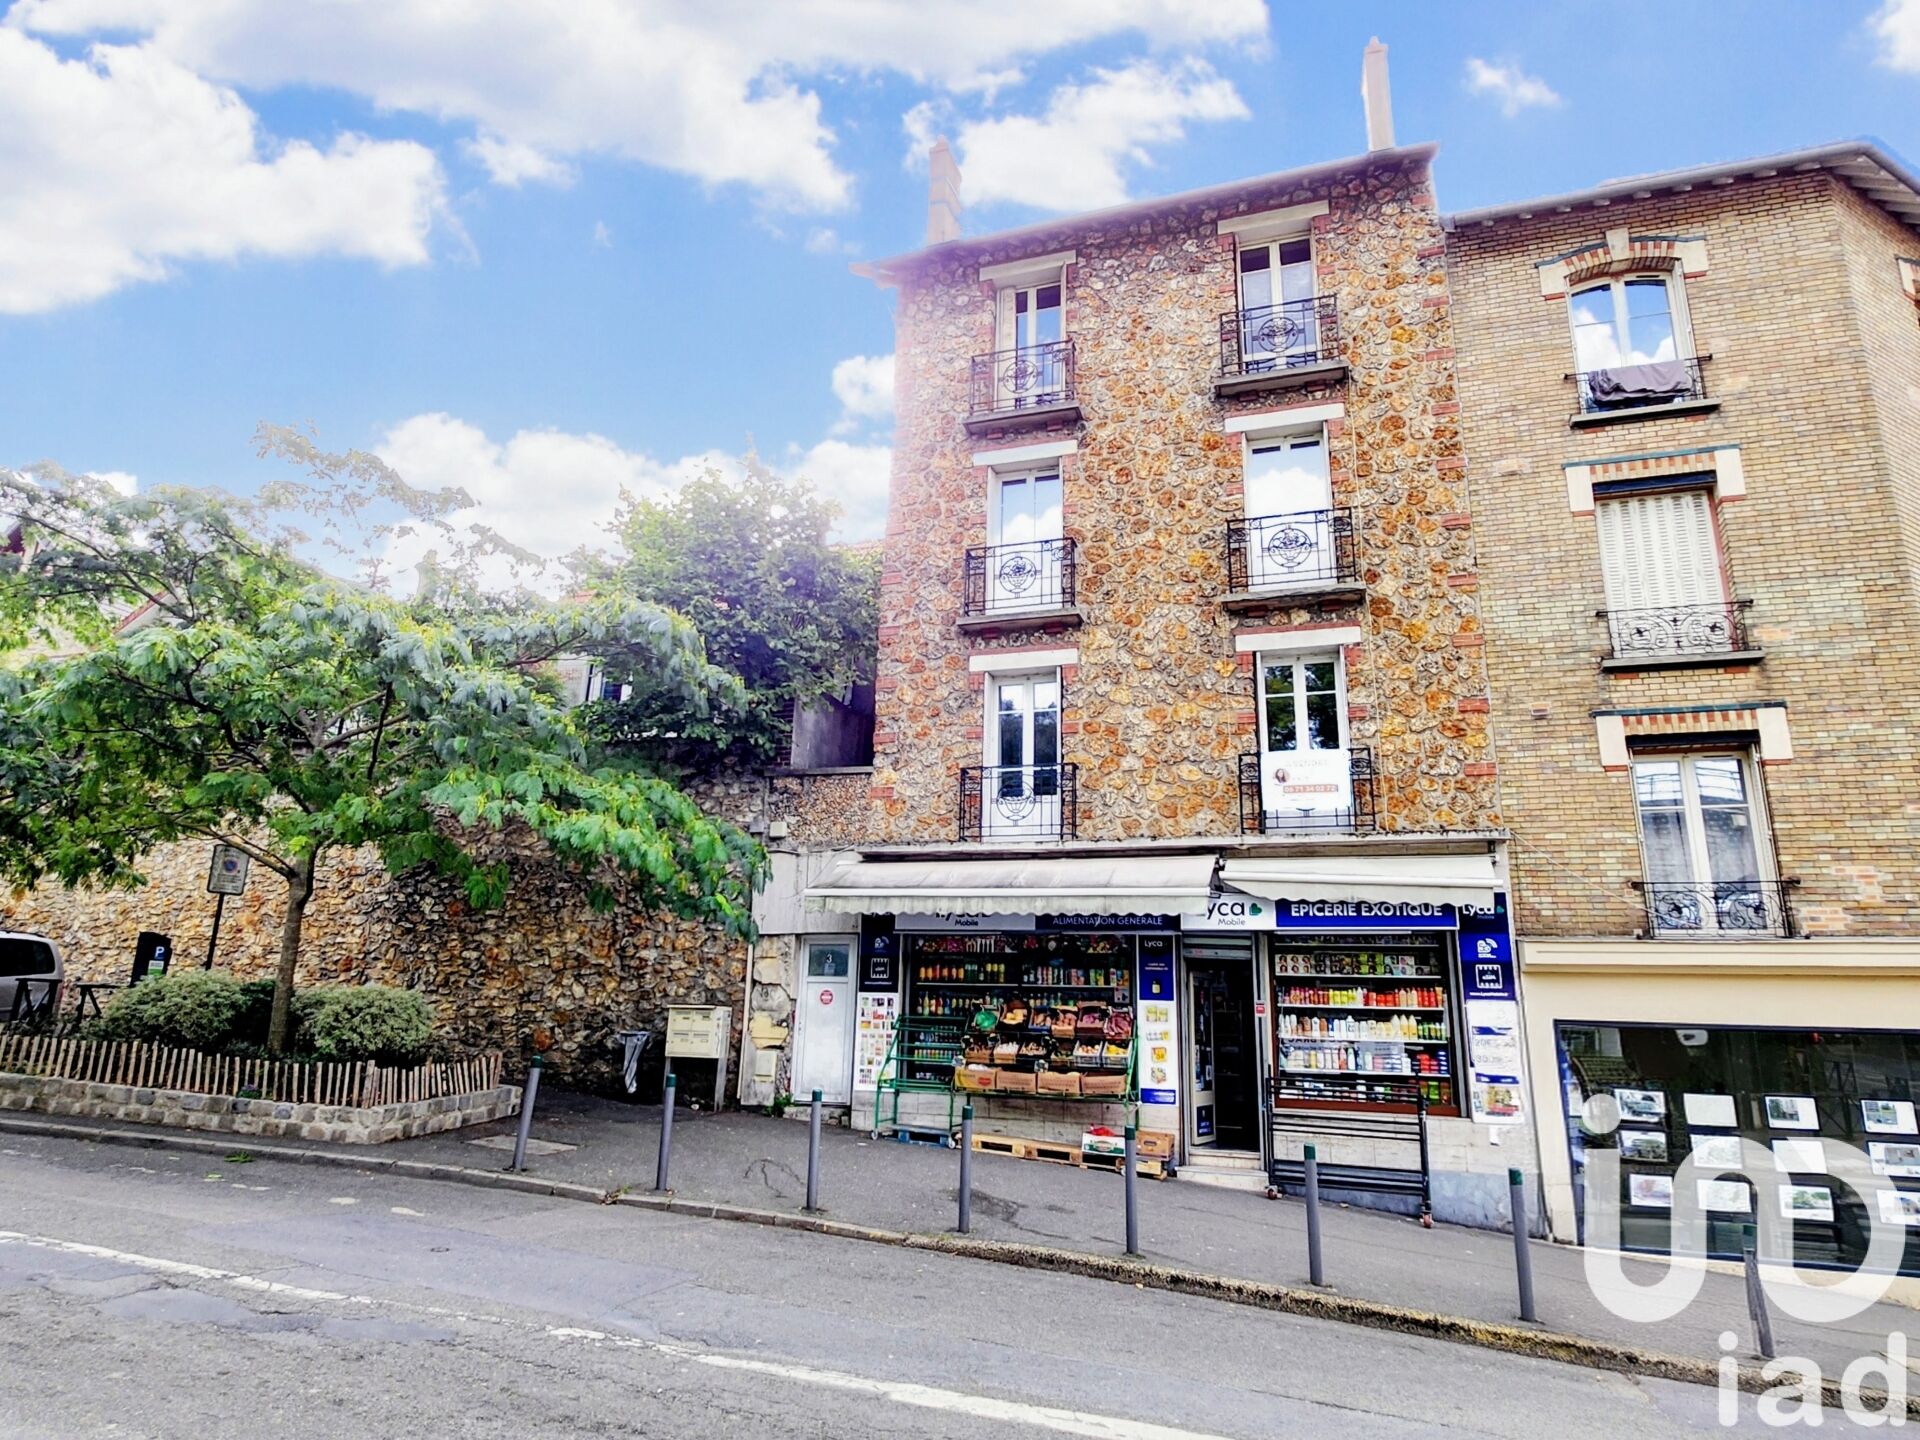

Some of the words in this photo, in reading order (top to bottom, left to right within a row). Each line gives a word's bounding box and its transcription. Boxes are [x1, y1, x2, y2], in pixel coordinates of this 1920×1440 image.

[1207, 901, 1245, 920] yca
[1291, 903, 1357, 917] EPICERIE
[1361, 903, 1443, 917] EXOTIQUE
[1462, 904, 1495, 917] Lyca
[955, 919, 979, 927] Mobile
[1052, 916, 1115, 925] ALIMENTATION
[1117, 916, 1163, 925] GENERALE
[1218, 918, 1246, 926] Mobile
[1144, 940, 1163, 948] Lyca
[155, 946, 165, 957] P
[826, 953, 833, 963] 3
